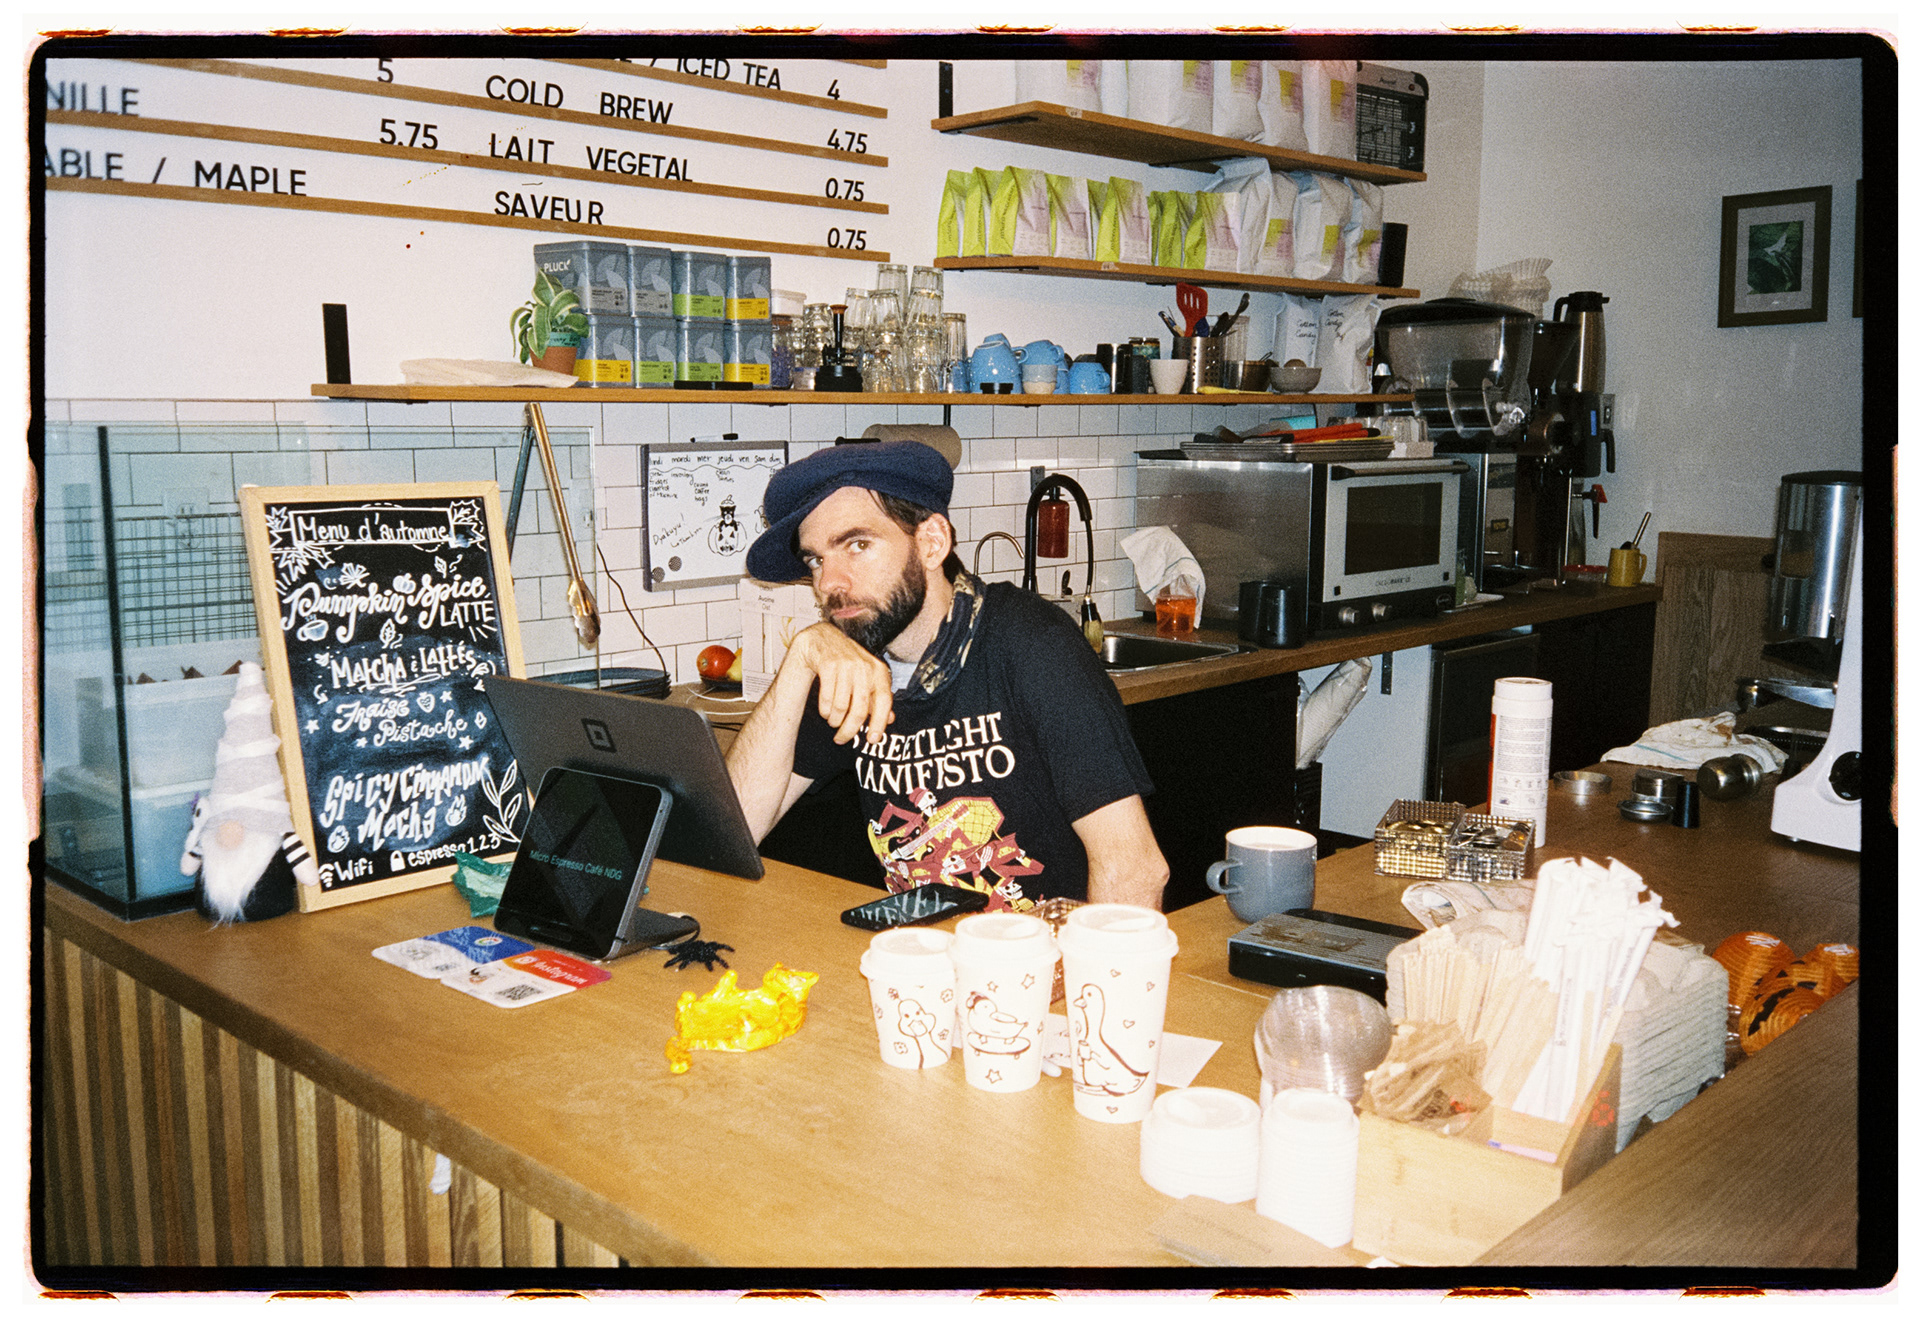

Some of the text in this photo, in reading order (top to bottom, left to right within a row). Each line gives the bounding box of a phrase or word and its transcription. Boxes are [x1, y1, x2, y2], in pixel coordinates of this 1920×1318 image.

[377, 58, 393, 83] 5
[677, 58, 841, 100] ICED TEA 4
[485, 75, 868, 154] COLD BREW 4.75
[379, 118, 438, 150] 5.75
[194, 160, 307, 197] MAPLE
[490, 133, 865, 202] LAIT VEGETAL 0.75
[494, 190, 867, 251] SAVEUR 0.75
[544, 261, 571, 273] PLUCK
[298, 512, 450, 542] Menu d'automne
[281, 574, 486, 643] Pumpkin Spice
[440, 601, 496, 629] LATTE
[332, 697, 410, 733] Fraise
[373, 709, 468, 747] Pistache
[334, 857, 374, 882] Wifi
[529, 849, 622, 880] Micro Espresso Café NDG
